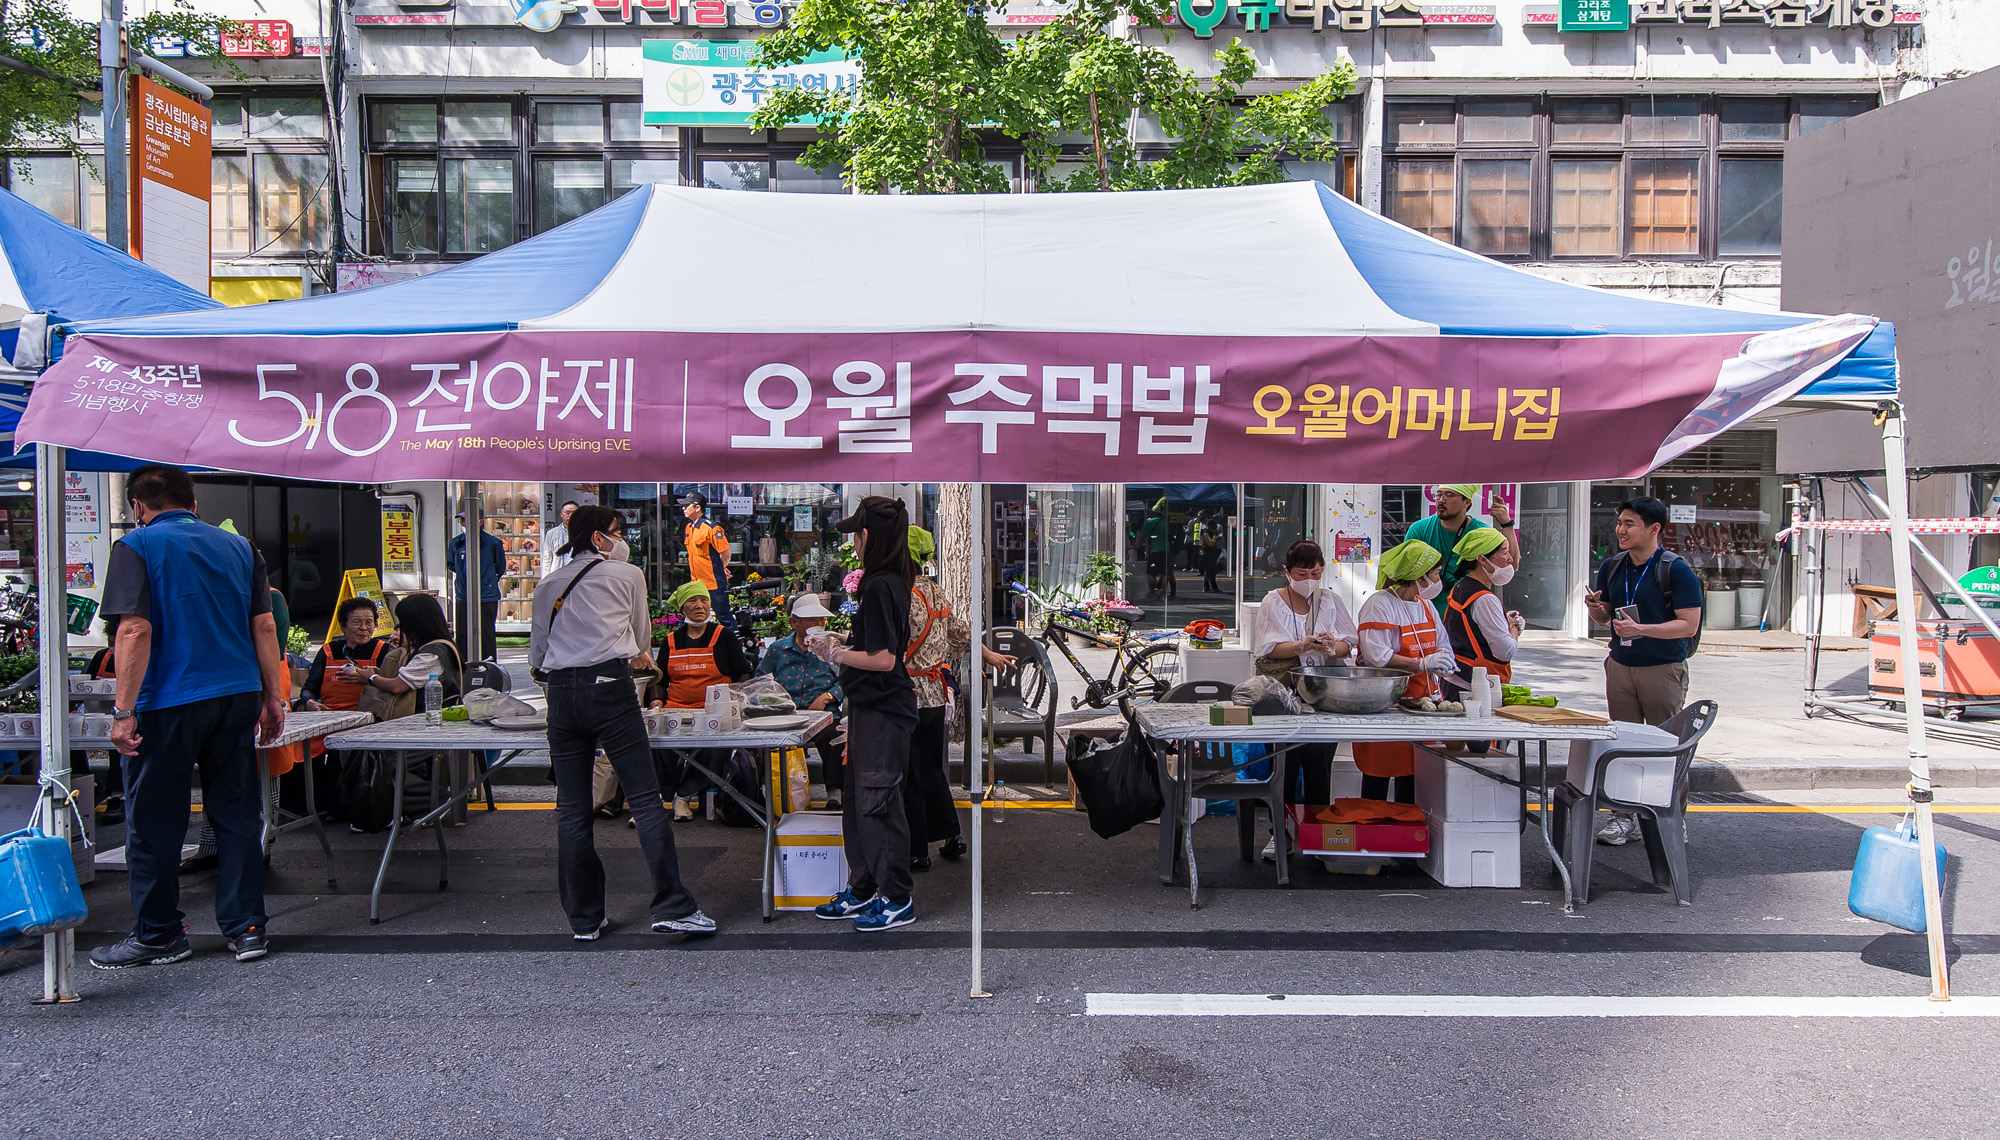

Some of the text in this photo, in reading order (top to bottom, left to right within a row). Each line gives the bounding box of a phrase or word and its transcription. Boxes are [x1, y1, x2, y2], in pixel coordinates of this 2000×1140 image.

[1430, 6, 1488, 15] T.227-7422
[1577, 0, 1611, 10] 고려조
[144, 92, 208, 136] 광주시립미술관
[144, 112, 192, 148] 금남로분관
[145, 134, 171, 151] Gwangju
[145, 143, 169, 160] Museum
[145, 153, 161, 165] of Art
[85, 354, 120, 374] 제
[62, 391, 150, 416] 기념행사
[408, 357, 635, 433] 전야제
[730, 360, 1562, 456] 오월 주먹밥 오월어머니집
[400, 436, 632, 453] The May 18th People's Uprising EVE
[385, 521, 413, 560] 부동산
